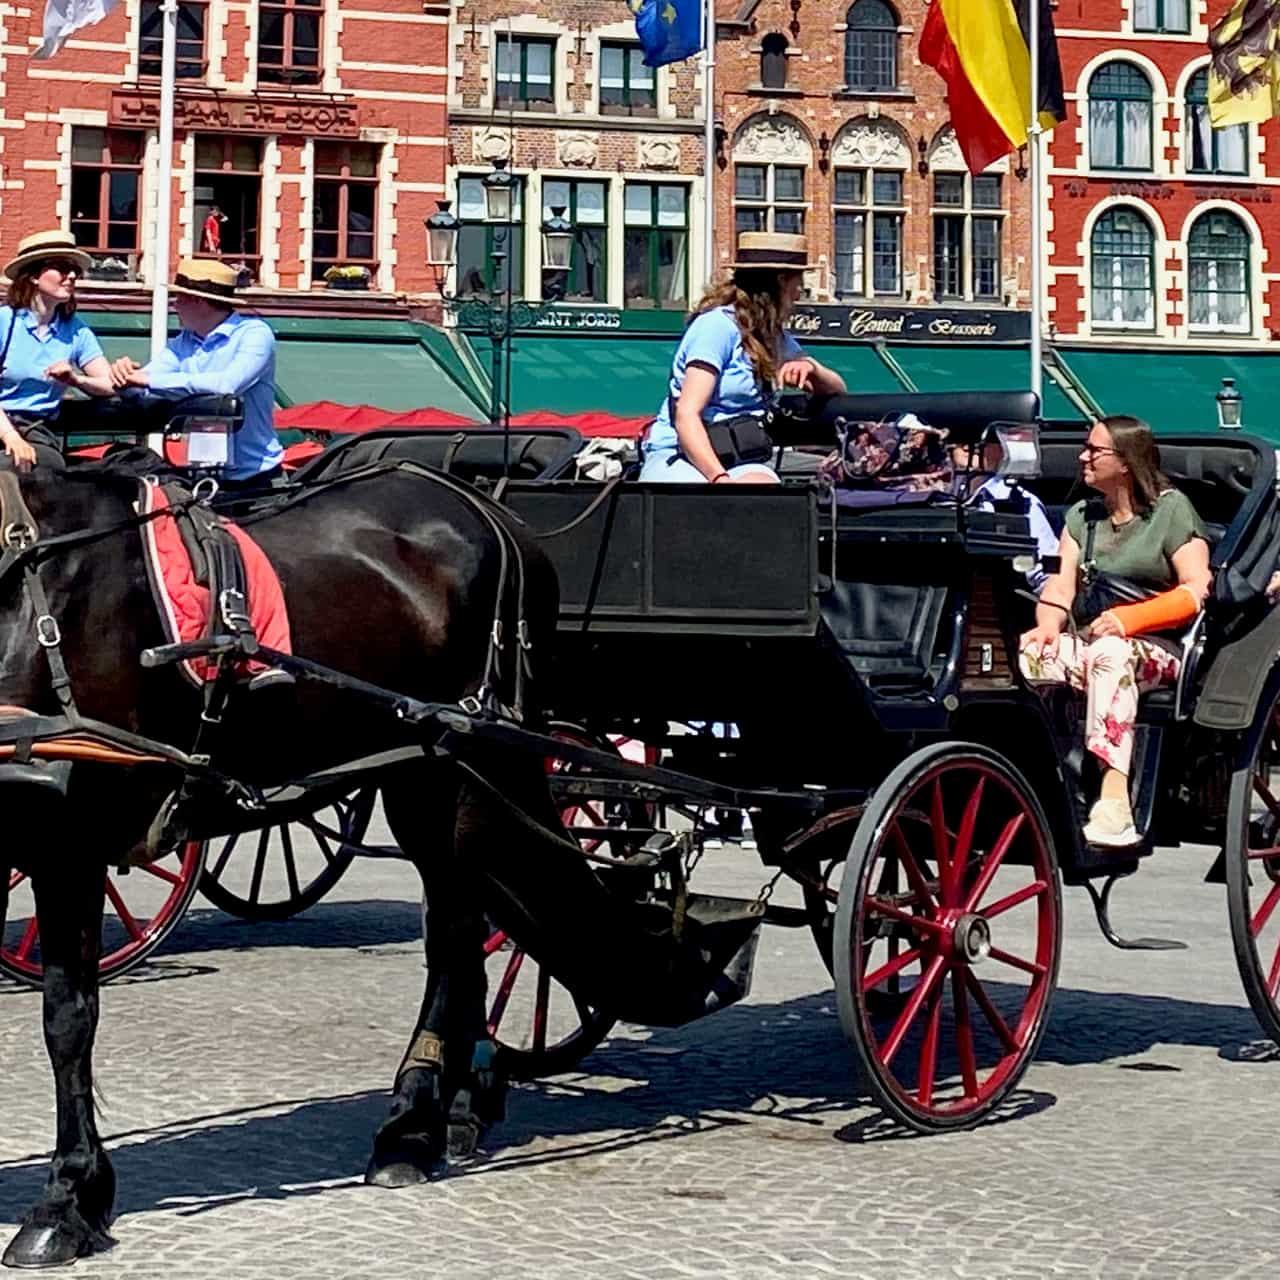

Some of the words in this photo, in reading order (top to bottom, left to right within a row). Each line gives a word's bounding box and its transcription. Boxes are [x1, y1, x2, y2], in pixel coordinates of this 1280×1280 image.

[576, 312, 621, 328] JORIS
[848, 308, 905, 337] Central
[928, 319, 997, 336] Brasserie
